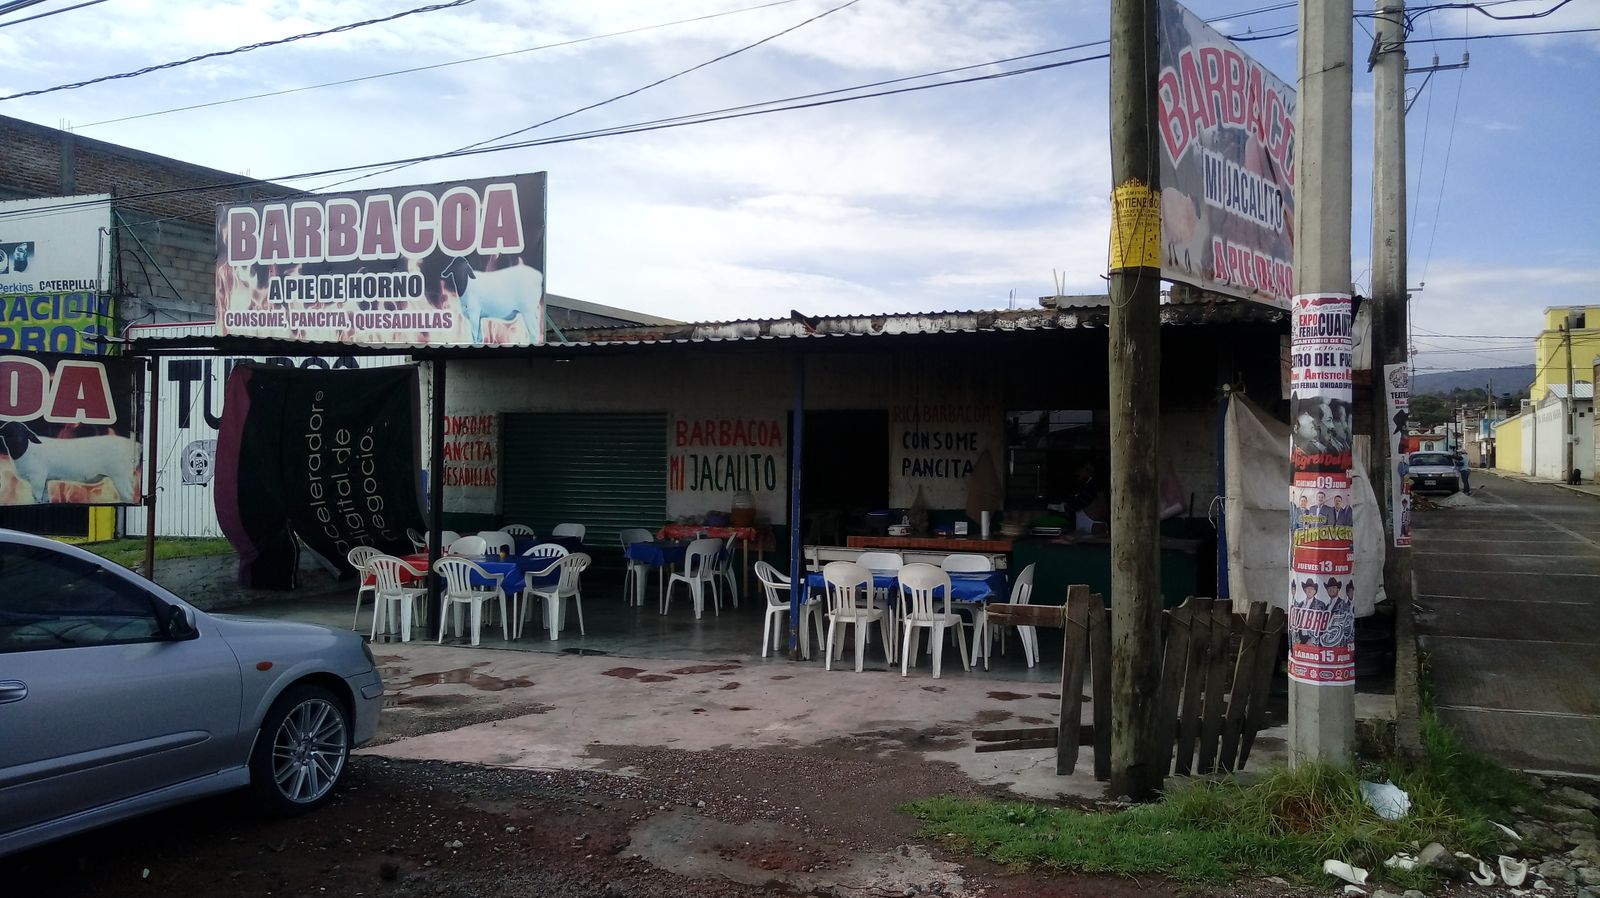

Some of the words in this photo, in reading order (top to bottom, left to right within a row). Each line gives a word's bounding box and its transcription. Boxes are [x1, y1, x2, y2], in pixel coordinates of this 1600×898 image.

[1205, 154, 1222, 203] MI
[1226, 162, 1283, 228] JACALITO
[228, 187, 522, 262] BARBACOA
[1214, 240, 1227, 280] A
[1230, 247, 1254, 288] PIE
[1255, 255, 1275, 291] DE
[270, 278, 281, 300] A
[286, 277, 314, 300] PIE
[320, 277, 344, 299] DE
[348, 274, 423, 299] HORNO
[226, 312, 287, 329] CONSOME,
[291, 312, 350, 330] PANCITA,
[355, 312, 453, 329] QUESADILLAS
[1299, 314, 1318, 326] EXPO
[1299, 326, 1318, 337] FERIA
[1314, 352, 1336, 366] DEL
[443, 415, 493, 436] ONSOME
[676, 420, 782, 447] BARBACOA
[331, 428, 351, 464] de
[443, 441, 493, 461] ANCITA
[902, 431, 978, 451] CONSOME
[670, 455, 685, 491] MI
[690, 454, 776, 491] JACALITO
[902, 457, 973, 478] PANCITA
[1316, 476, 1333, 488] 09
[1297, 562, 1319, 571] JUEVES
[1319, 560, 1333, 572] 13
[1320, 650, 1335, 662] 15
